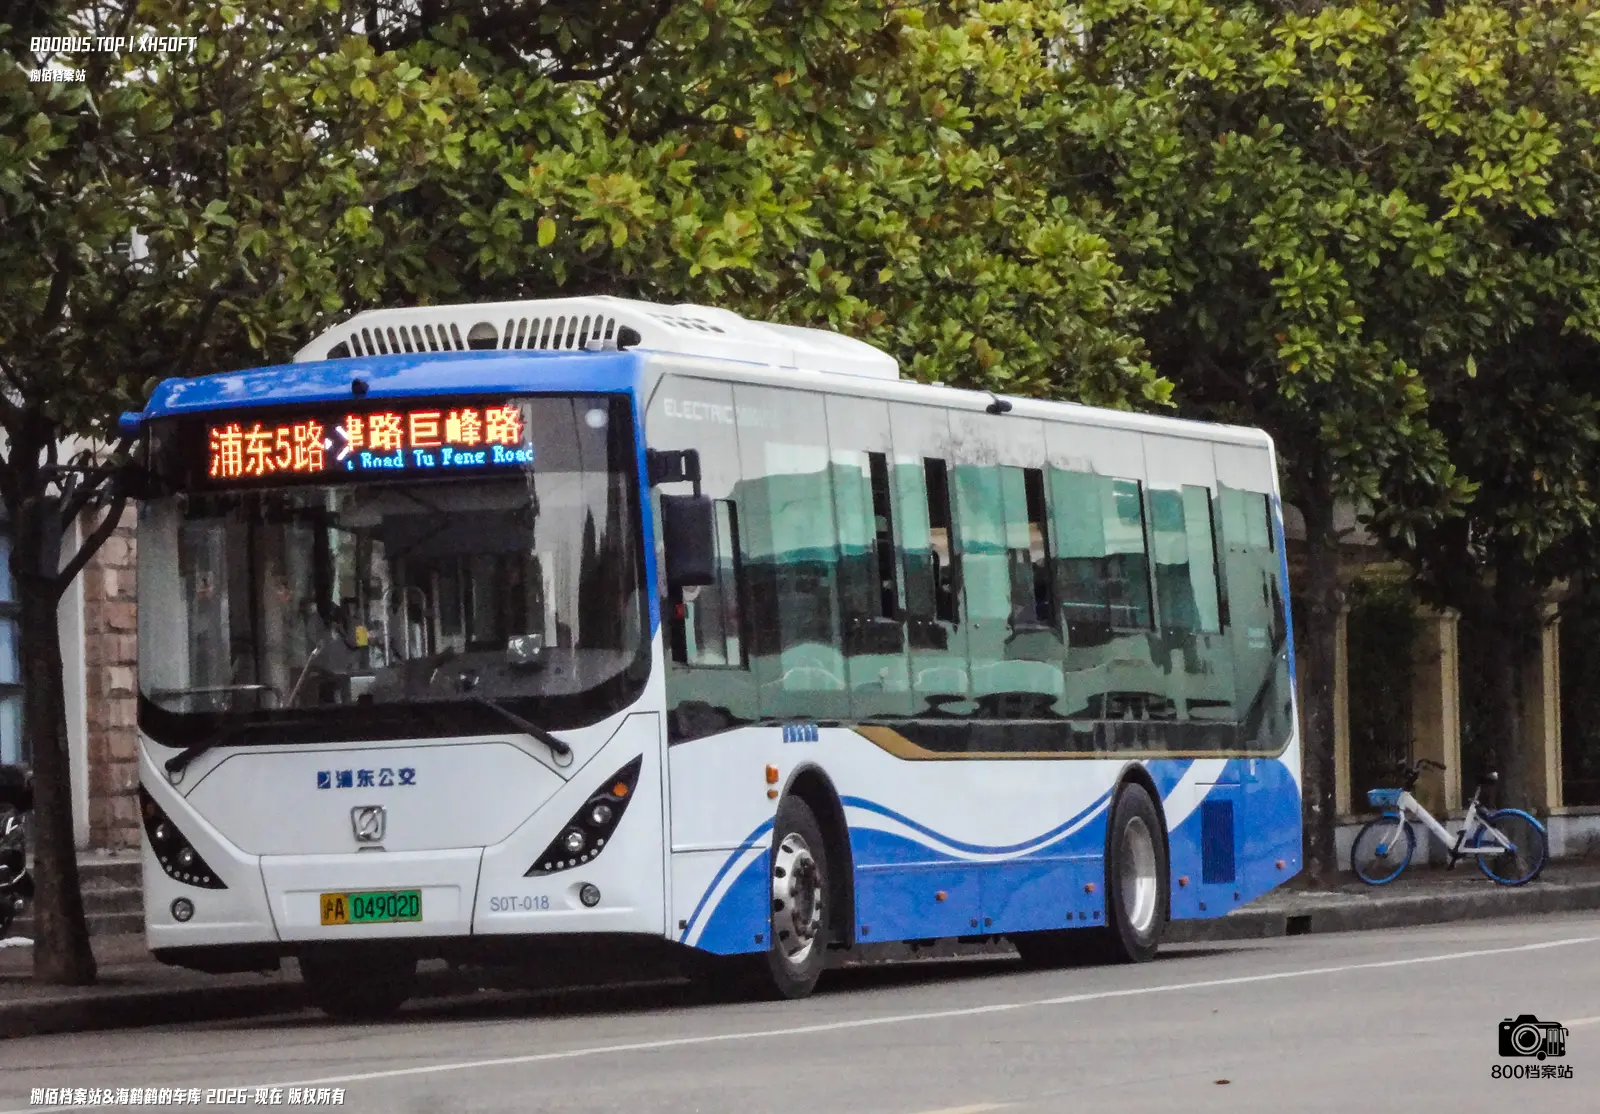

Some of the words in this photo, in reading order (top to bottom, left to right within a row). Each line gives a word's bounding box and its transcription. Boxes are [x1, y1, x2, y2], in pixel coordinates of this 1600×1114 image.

[209, 419, 325, 477] 浦东5路
[335, 767, 417, 789] 浦东公交
